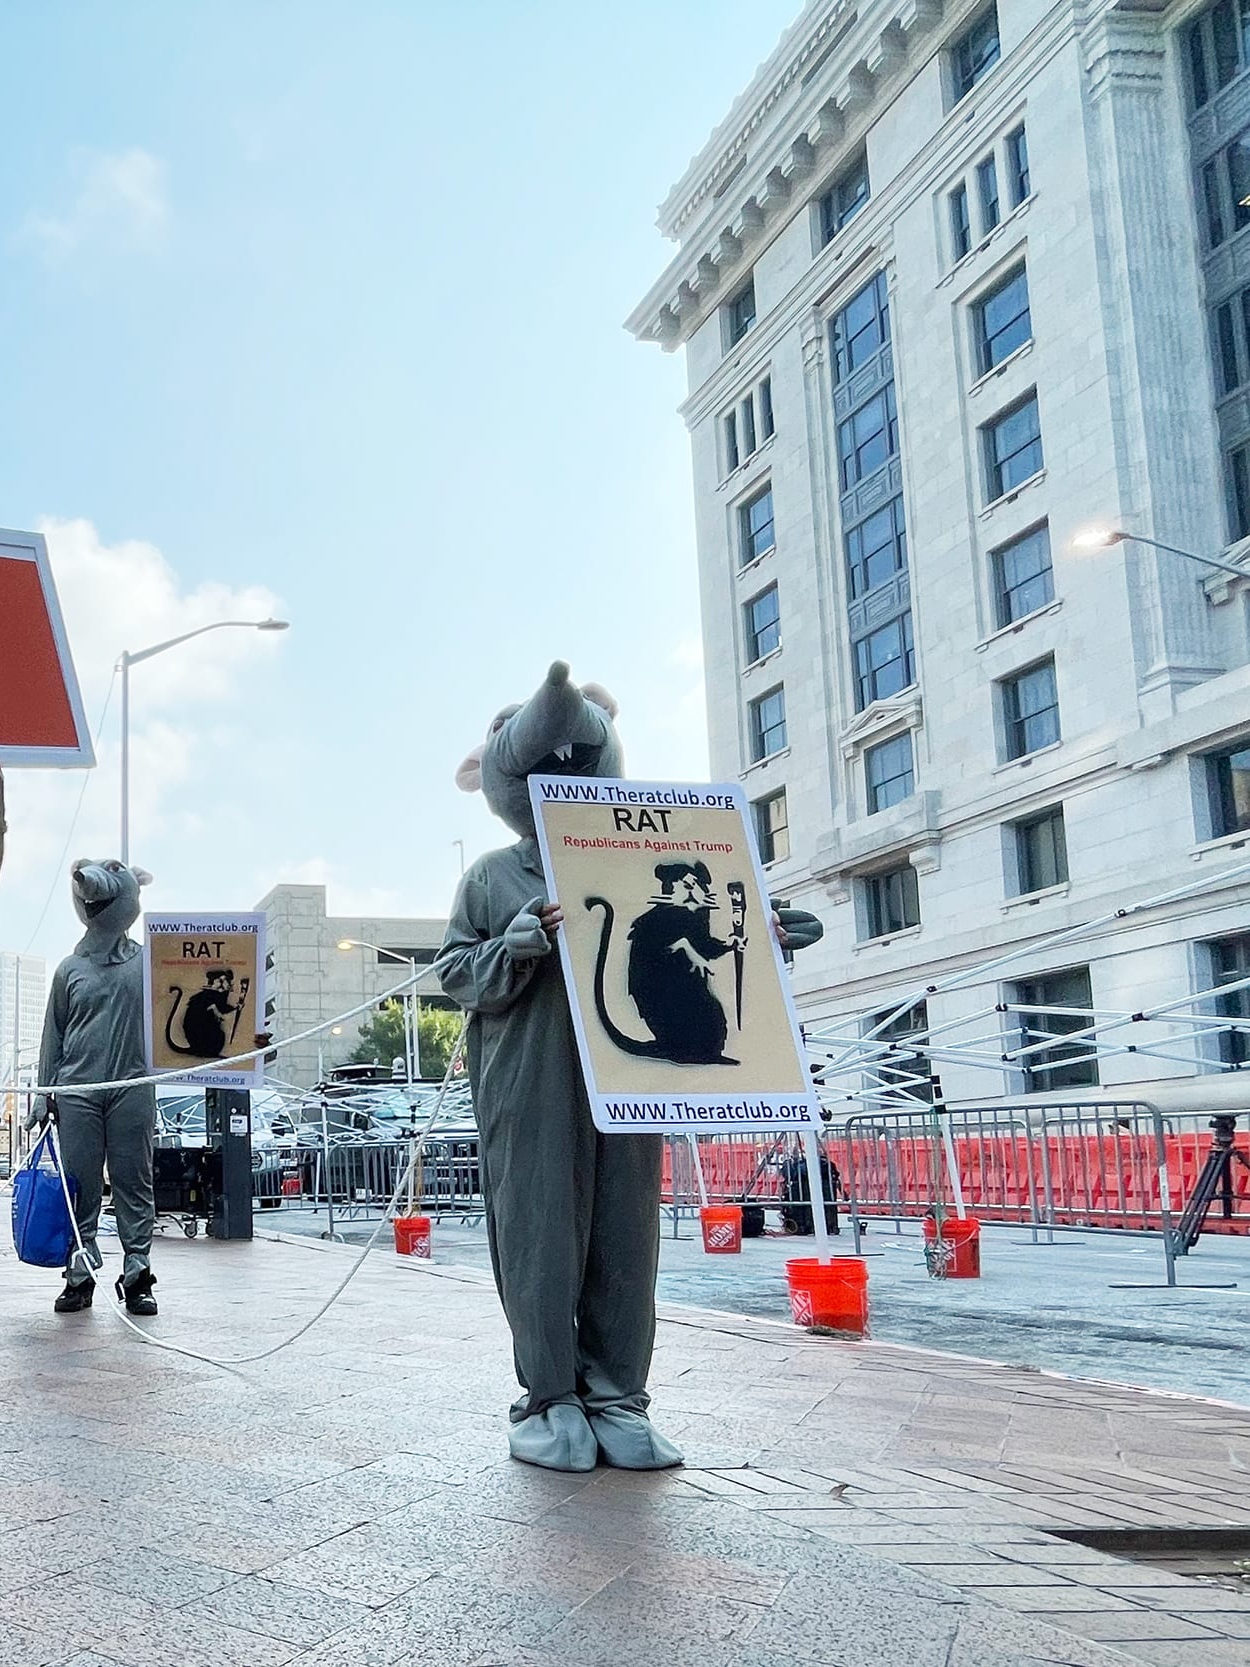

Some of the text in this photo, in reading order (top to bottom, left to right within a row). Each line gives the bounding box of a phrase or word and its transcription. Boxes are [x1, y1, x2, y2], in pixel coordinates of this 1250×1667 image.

[540, 782, 735, 810] WWW.Theratclub.org
[612, 807, 672, 833] RAT
[563, 835, 734, 854] Republicans Against Trump
[148, 922, 259, 933] WWW.Theratclub.org
[182, 941, 226, 958] RAT
[605, 1101, 810, 1121] WWW.Theratclub.org
